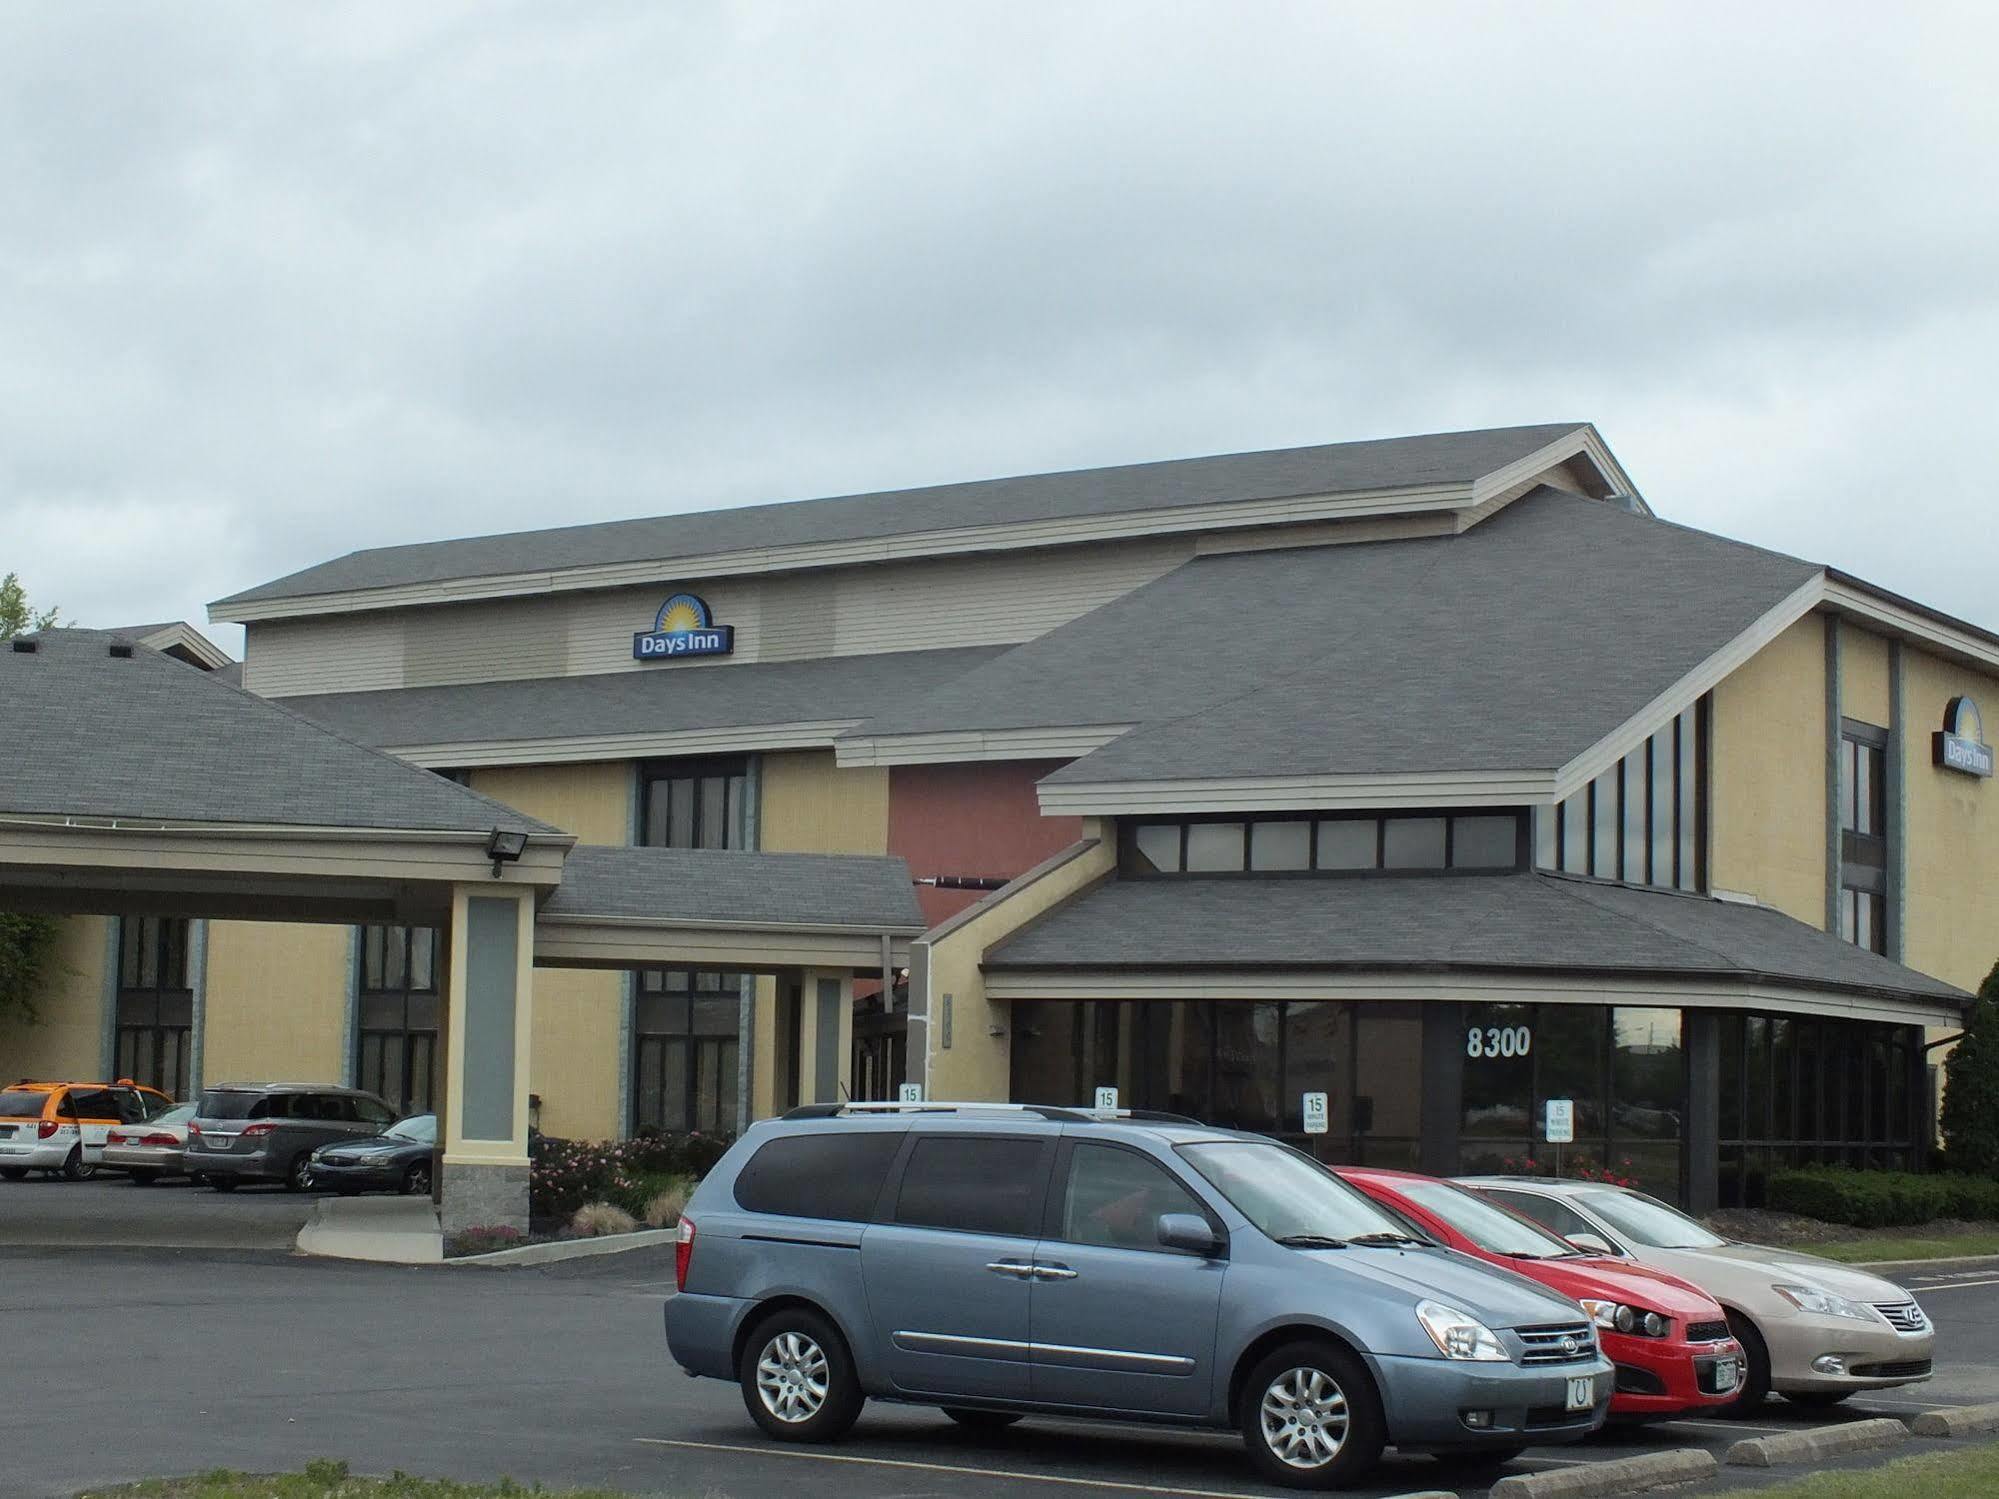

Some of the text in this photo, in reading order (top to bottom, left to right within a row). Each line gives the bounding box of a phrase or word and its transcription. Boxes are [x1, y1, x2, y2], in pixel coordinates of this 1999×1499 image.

[641, 633, 720, 654] Days Inn
[1948, 740, 1989, 770] Days Inn
[1467, 1026, 1531, 1058] 8300
[905, 1089, 920, 1105] 15
[1100, 1092, 1114, 1106] 15
[1307, 1098, 1323, 1112] 15
[1554, 1105, 1566, 1116] 15
